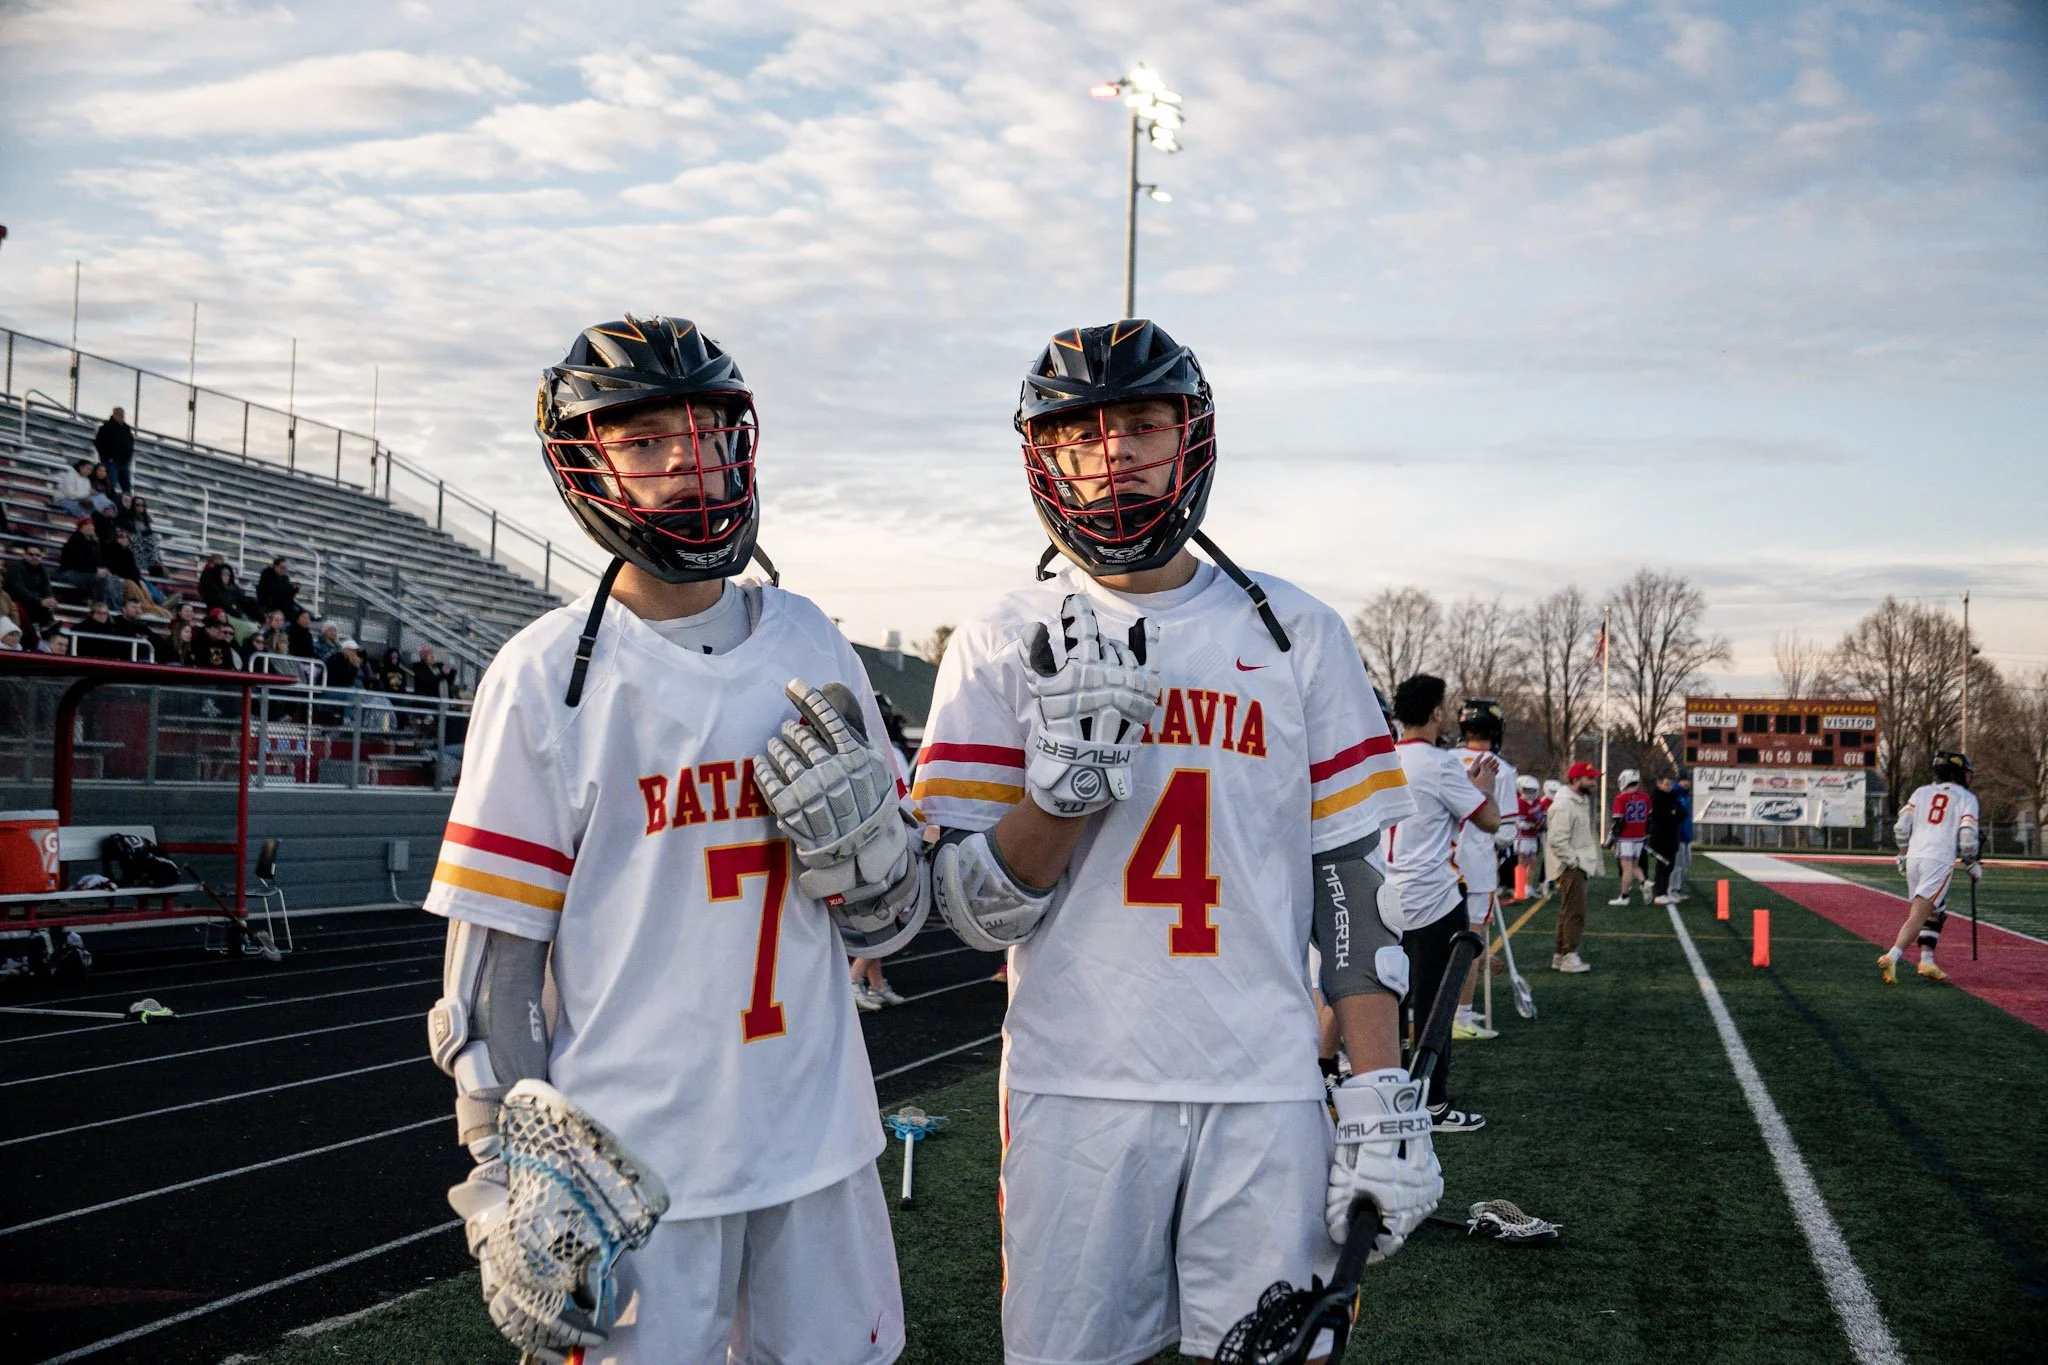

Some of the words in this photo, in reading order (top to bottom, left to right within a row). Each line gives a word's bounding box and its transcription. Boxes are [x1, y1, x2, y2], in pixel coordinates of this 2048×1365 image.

[560, 430, 622, 498] cscde
[1034, 441, 1071, 498] ascde
[1141, 688, 1267, 758] AVIA
[1695, 716, 1730, 726] HOME
[1825, 718, 1874, 729] VISITOR
[1036, 736, 1130, 764] MAVERI
[1697, 750, 1728, 762] DOWN
[1759, 750, 1774, 763] TO
[1776, 751, 1792, 764] GO
[1797, 751, 1812, 764] ON
[1843, 752, 1864, 766] QTR
[637, 757, 770, 836] BATA
[1625, 801, 1647, 822] 22
[1927, 793, 1949, 825] 8
[1124, 767, 1221, 958] 4
[1322, 864, 1350, 971] MAVERIK
[704, 838, 790, 1044] 7
[528, 1000, 542, 1042] STX
